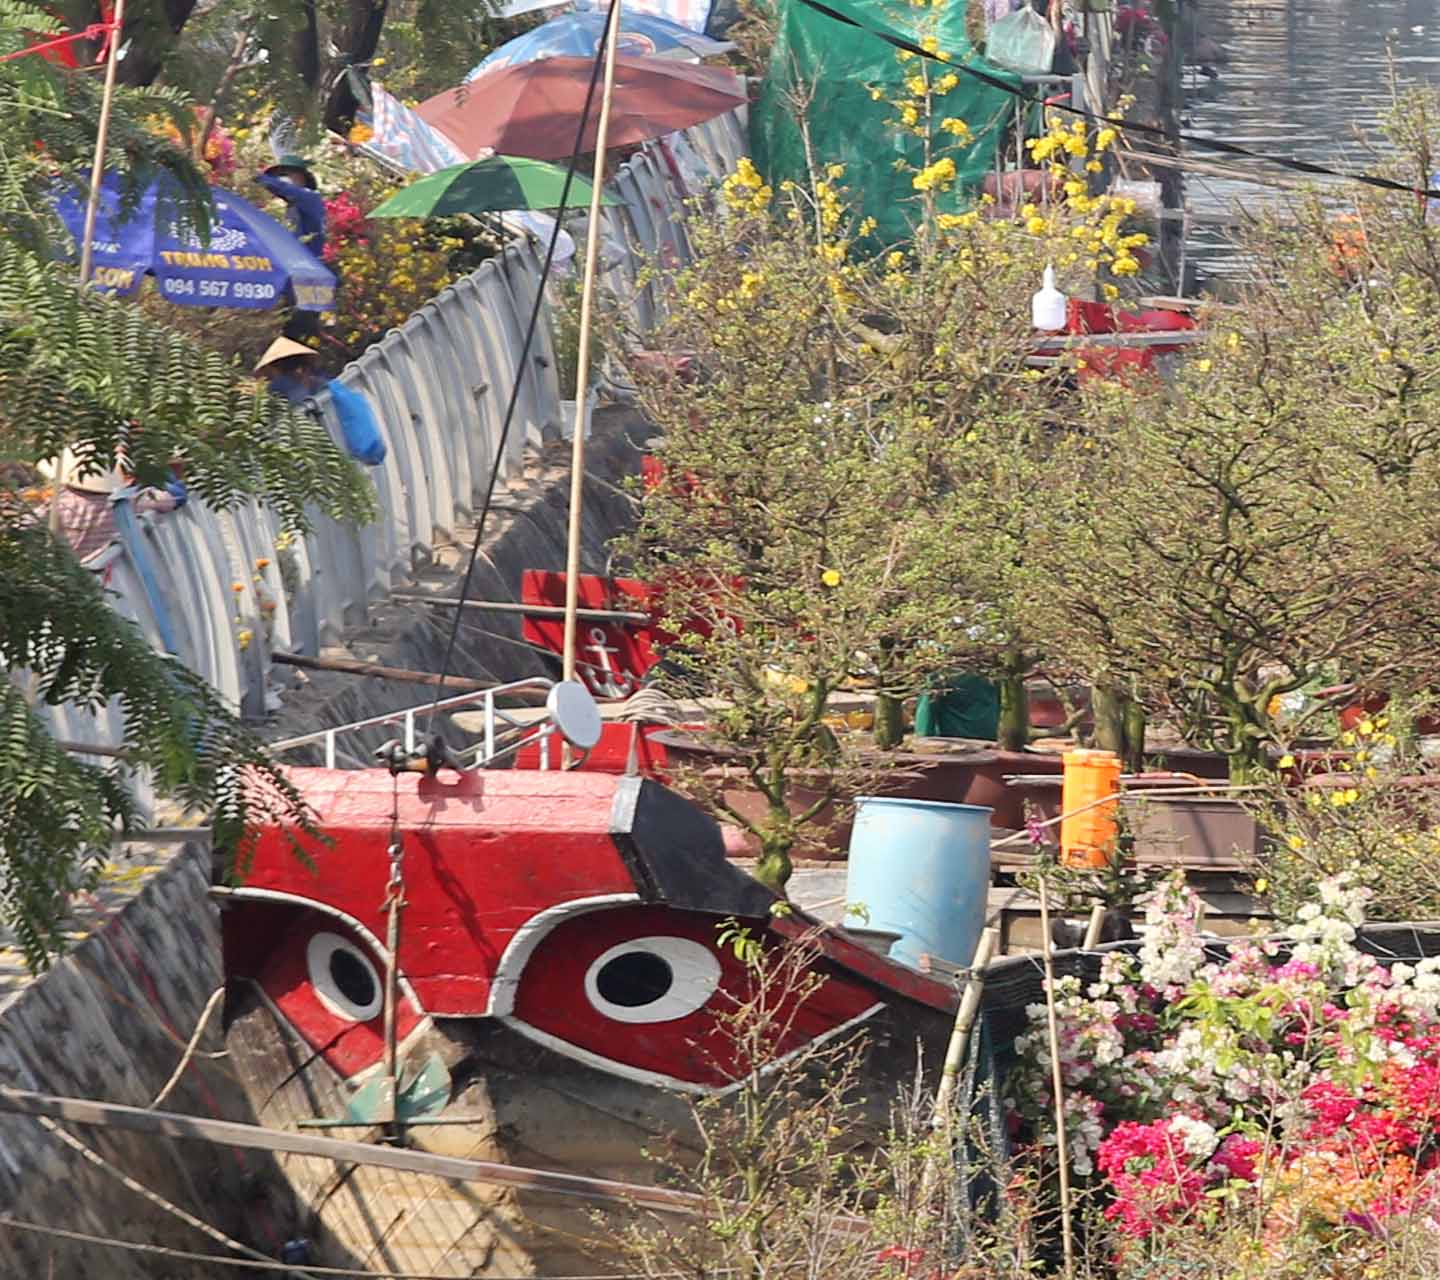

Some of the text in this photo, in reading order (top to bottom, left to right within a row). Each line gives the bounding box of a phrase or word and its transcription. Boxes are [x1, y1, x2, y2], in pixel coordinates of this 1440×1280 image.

[160, 251, 229, 269] TRUNG
[164, 278, 194, 295] 094
[199, 281, 229, 297] 567
[233, 282, 275, 299] 9930
